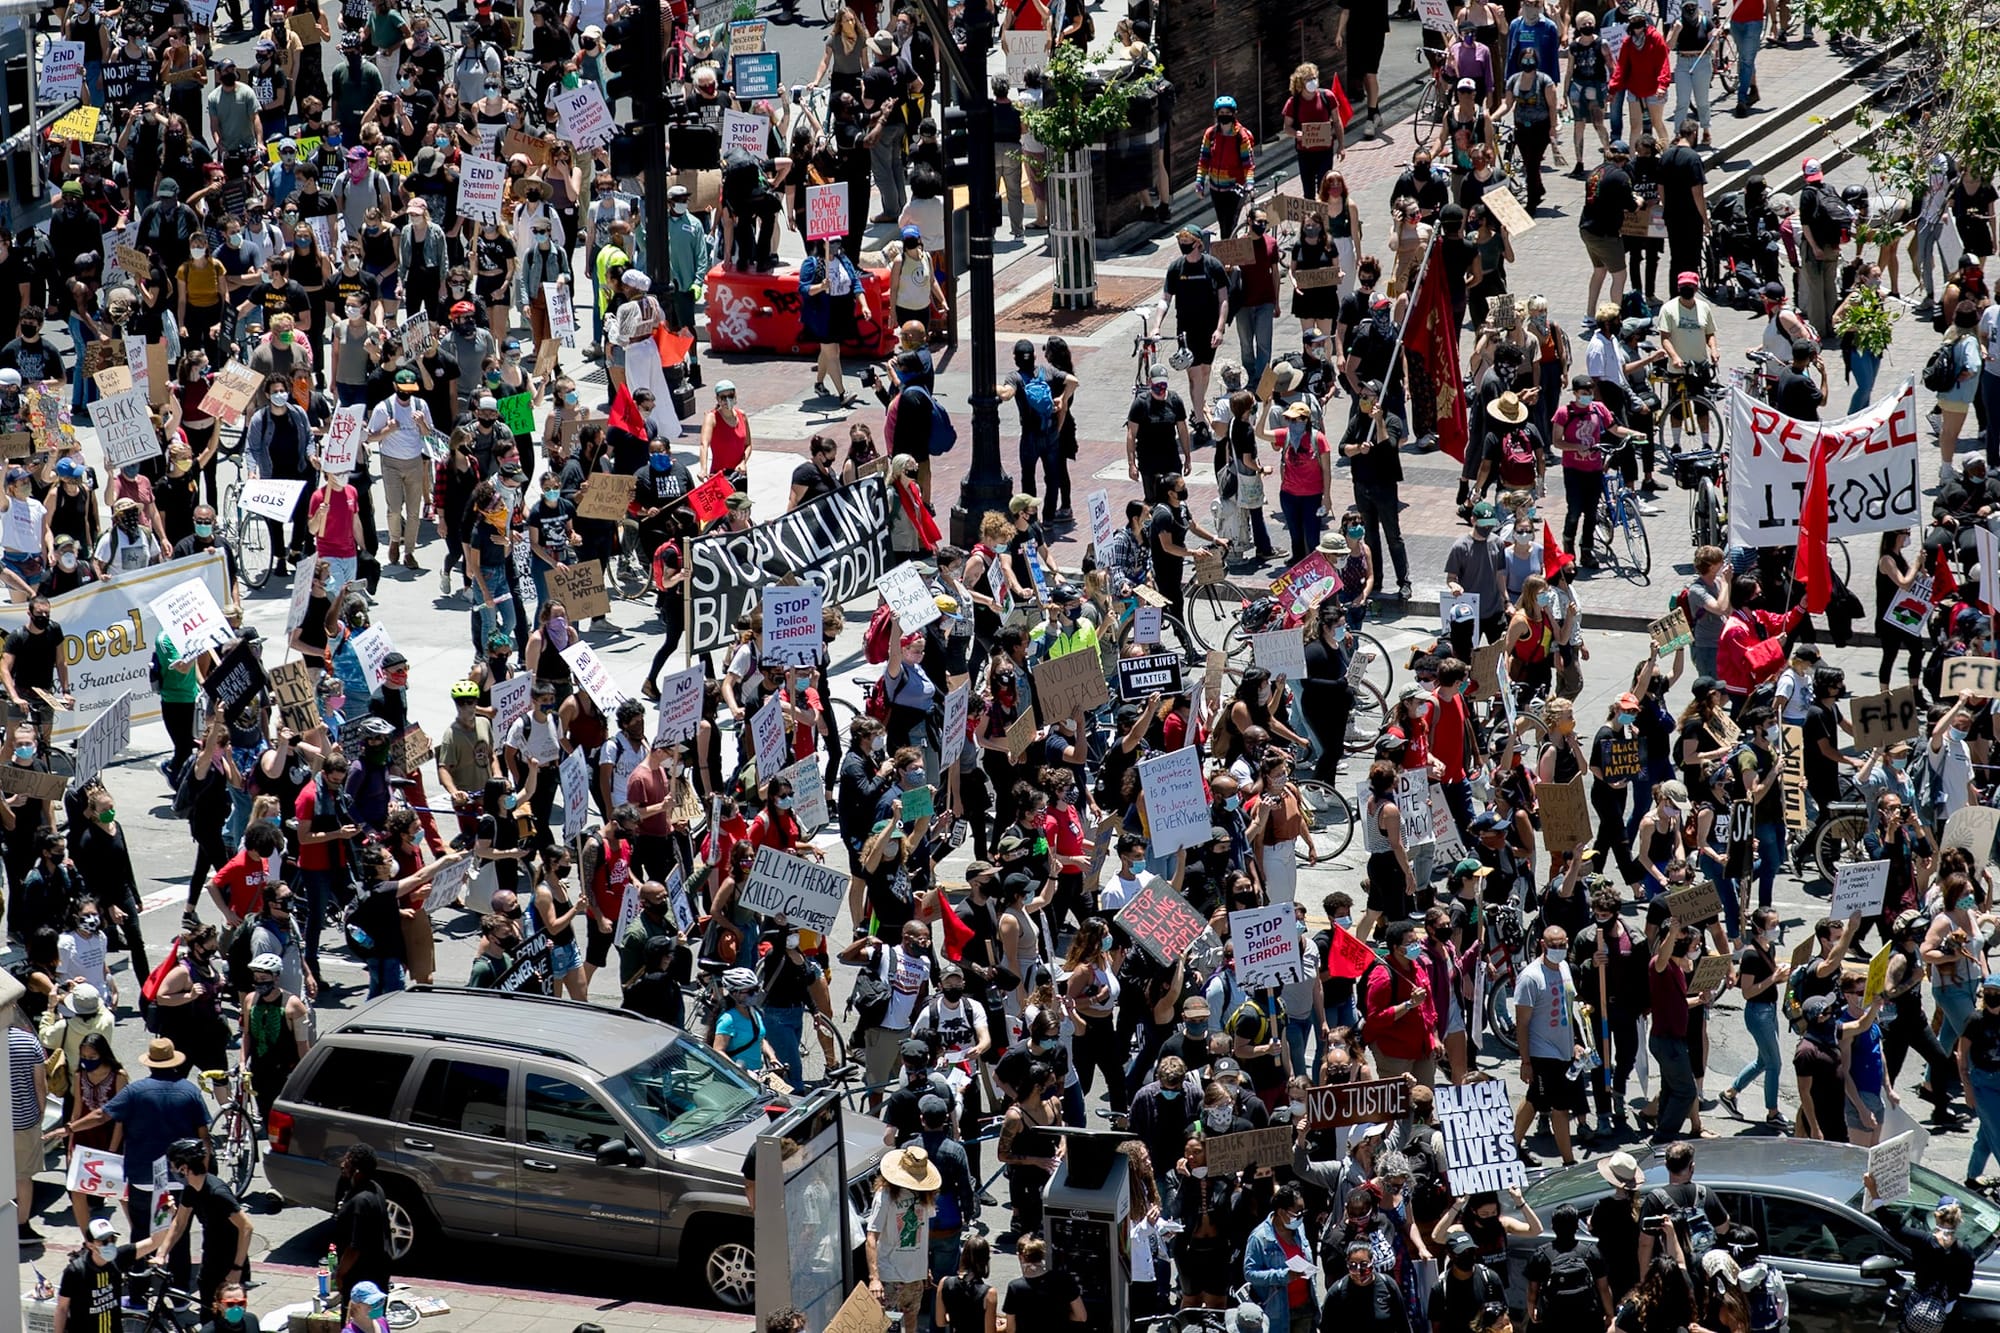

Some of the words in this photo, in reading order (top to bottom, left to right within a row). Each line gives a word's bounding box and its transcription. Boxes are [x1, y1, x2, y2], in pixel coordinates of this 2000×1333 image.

[1427, 6, 1444, 17] ALL
[1010, 36, 1038, 53] CARE
[53, 50, 75, 62] END
[45, 62, 82, 74] Systemic
[103, 67, 117, 80] NO
[47, 72, 77, 84] Racism!
[108, 84, 123, 97] NO
[571, 94, 588, 111] NO
[731, 123, 759, 134] STOP
[513, 130, 546, 149] LIVES
[732, 134, 757, 144] Police
[470, 168, 494, 181] END
[463, 180, 500, 193] Systemic
[464, 190, 497, 202] Racism!
[819, 187, 833, 196] ALL
[811, 195, 841, 211] POWER
[810, 213, 848, 232] PEOPLE!
[815, 210, 823, 218] TO
[551, 294, 567, 306] STOP
[223, 390, 233, 401] IS
[96, 398, 142, 429] BLACK
[107, 421, 141, 442] LIVES
[105, 434, 157, 463] MATTER
[324, 453, 352, 465] ATTER
[254, 493, 286, 508] STOP
[1094, 500, 1106, 520] END
[692, 528, 775, 592] STOP
[770, 477, 886, 572] KILLING
[553, 566, 592, 587] BLACK
[566, 577, 593, 592] LIVES
[879, 566, 916, 596] DEFUND
[1268, 573, 1294, 596] EAT
[174, 590, 193, 607] Injury
[774, 598, 810, 617] STOP
[891, 587, 933, 615] DISARM
[182, 612, 209, 636] ALL
[692, 588, 762, 650] BLA
[776, 614, 809, 628] Police
[906, 603, 940, 627] POLICE
[62, 608, 149, 668] ocal
[769, 624, 816, 642] TERROR!
[575, 651, 591, 671] END
[1121, 659, 1152, 672] BLACK
[1154, 655, 1177, 668] LIVES
[78, 664, 151, 693] Francisco,
[216, 662, 246, 694] DEFUND
[1042, 663, 1063, 684] NO
[1135, 672, 1167, 686] MATTER
[675, 677, 692, 695] NO
[500, 684, 527, 708] STOP
[1042, 692, 1064, 722] NO
[1065, 675, 1103, 703] PEACE
[502, 700, 526, 719] Police
[950, 694, 966, 720] END
[759, 706, 776, 738] STOP
[1611, 740, 1639, 754] BLACK
[1611, 753, 1640, 765] LIVES
[1605, 764, 1643, 777] MATTER
[572, 790, 584, 811] ALL
[754, 849, 781, 881] ALL
[782, 859, 803, 885] MY
[743, 877, 785, 911] KILLED
[1669, 885, 1715, 908] SILENCE
[1123, 888, 1155, 925] STOP
[1132, 895, 1177, 940] KILLING
[1153, 908, 1190, 946] BLACK
[1244, 917, 1283, 941] STOP
[516, 933, 547, 961] DEFUND
[1161, 918, 1204, 961] PEOPLE
[1248, 934, 1283, 952] Police
[1241, 940, 1293, 967] TERROR!
[1702, 957, 1729, 970] BLACK
[1309, 1089, 1337, 1123] NO
[1342, 1081, 1406, 1118] JUSTICE
[1434, 1078, 1510, 1115] BLACK
[1439, 1106, 1515, 1142] TRANS
[1209, 1135, 1242, 1152] BLACK
[1250, 1128, 1287, 1147] TRANS
[1445, 1135, 1518, 1168] LIVES
[1448, 1160, 1529, 1197] MATTER
[590, 1211, 616, 1220] GRAND
[616, 1214, 655, 1225] CHEROKEE
[91, 1283, 114, 1299] BLACK
[92, 1292, 115, 1307] LIVES
